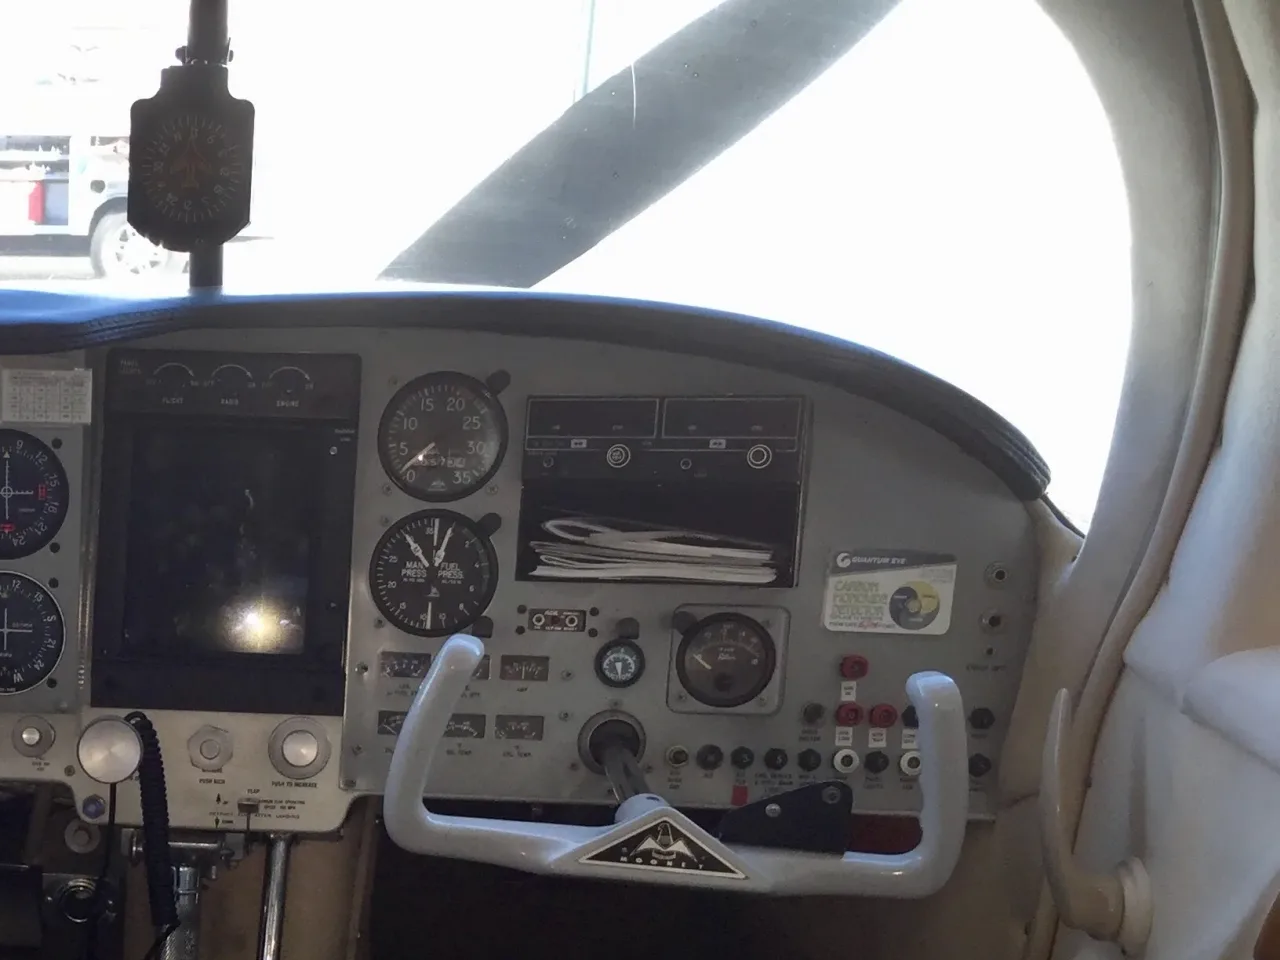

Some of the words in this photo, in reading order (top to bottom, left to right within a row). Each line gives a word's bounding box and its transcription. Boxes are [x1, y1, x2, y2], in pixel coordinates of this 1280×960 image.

[420, 398, 435, 412] 15
[446, 398, 466, 412] 20
[403, 417, 418, 430] 10
[462, 416, 481, 430] 25
[16, 439, 24, 450] 9
[399, 442, 408, 455] 5
[467, 441, 485, 455] 30
[35, 451, 48, 464] 12
[49, 473, 60, 487] 15
[406, 469, 416, 482] 0
[452, 470, 471, 484] 35
[12, 535, 27, 547] 24
[388, 555, 398, 563] 25
[440, 562, 460, 570] FUEL
[401, 569, 427, 578] PRESS
[12, 579, 21, 589] 12
[387, 581, 397, 589] 20
[620, 857, 704, 869] MOONEY
